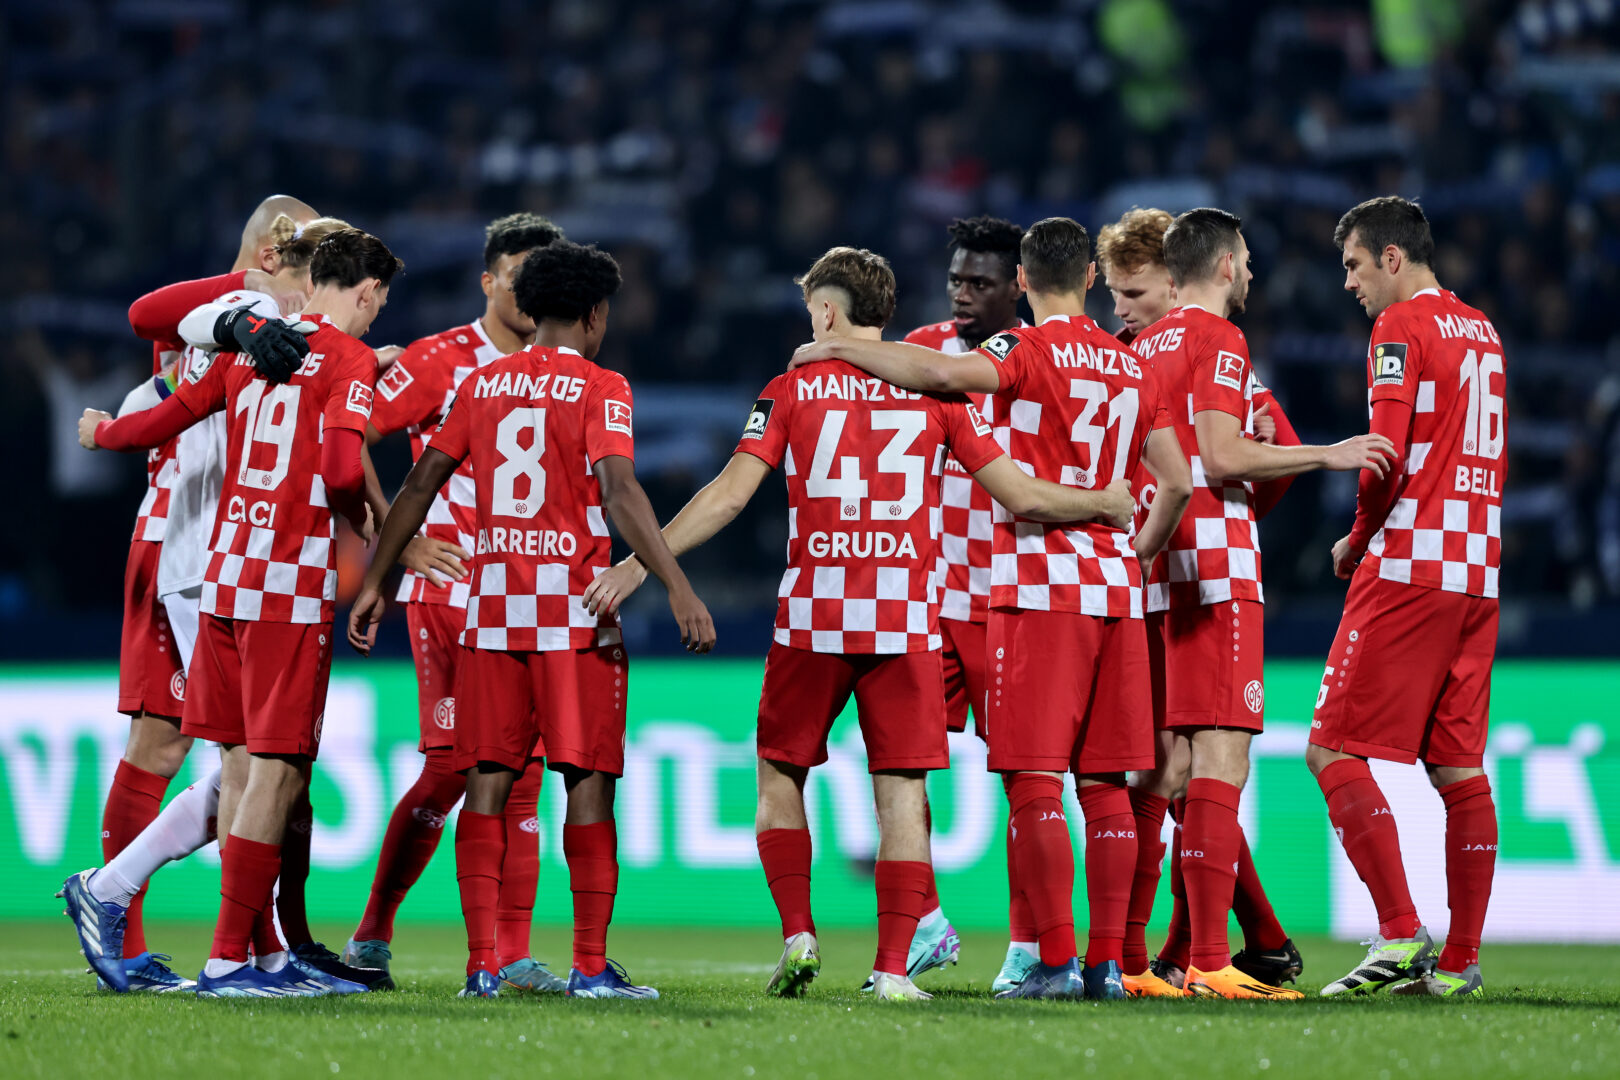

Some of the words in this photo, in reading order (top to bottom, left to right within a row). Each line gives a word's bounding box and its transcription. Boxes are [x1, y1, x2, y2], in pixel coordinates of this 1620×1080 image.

[1159, 327, 1186, 352] 05
[1434, 314, 1489, 343] MAINZ
[1118, 351, 1143, 380] 05
[473, 372, 550, 401] MAINZ
[550, 375, 586, 402] 05
[797, 374, 885, 402] MAINZ
[1459, 348, 1504, 461] 16
[235, 378, 302, 491] 19
[1059, 378, 1139, 489] 31
[491, 406, 547, 519] 8
[805, 409, 927, 521] 43
[1454, 464, 1500, 499] BELL
[807, 530, 919, 559] GRUDA
[1094, 830, 1135, 839] JAKO
